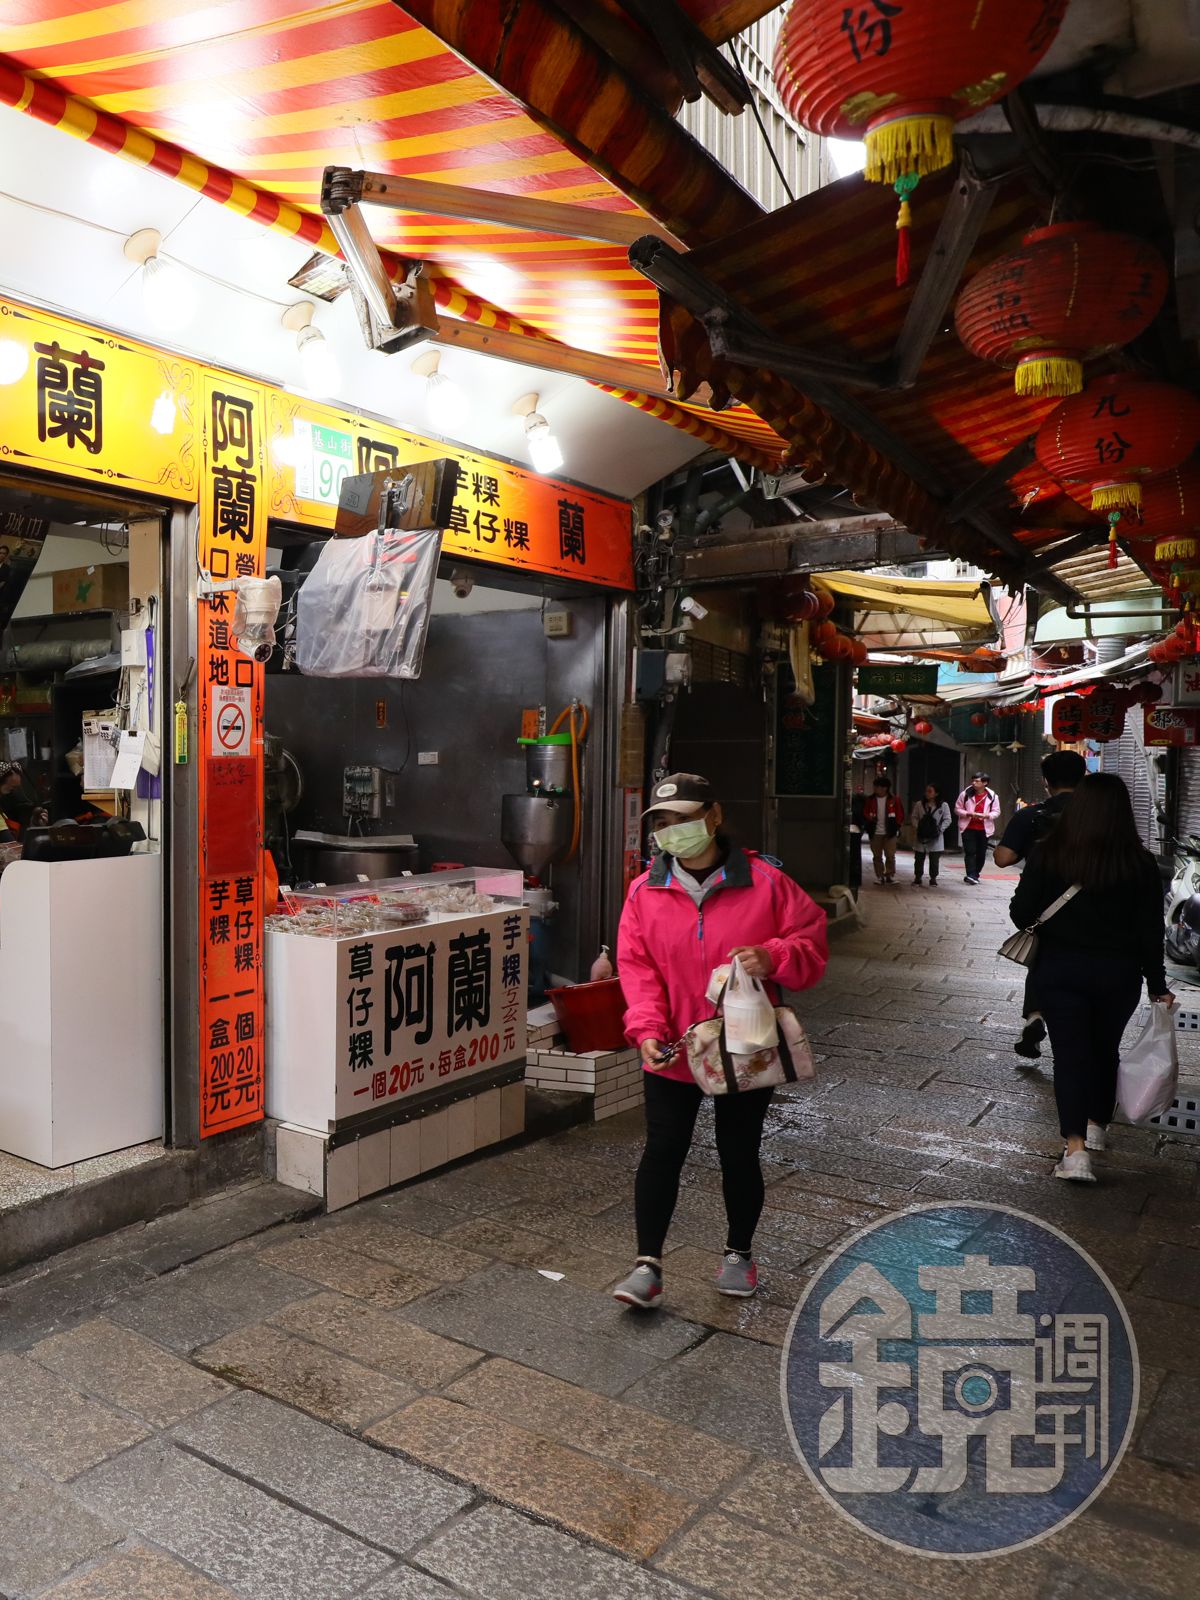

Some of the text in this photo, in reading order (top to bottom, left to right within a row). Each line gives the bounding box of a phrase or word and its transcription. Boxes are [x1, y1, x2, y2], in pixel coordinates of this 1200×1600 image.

[34, 339, 105, 455] 蘭
[1092, 394, 1132, 464] 九份
[211, 390, 257, 544] 阿蘭
[319, 459, 350, 499] 90
[450, 504, 531, 552] 草仔粿
[557, 498, 586, 565] 蘭
[209, 879, 231, 945] 芋粿
[233, 876, 255, 974] 草仔粿
[346, 941, 374, 1073] 草仔粿
[384, 927, 492, 1057] 阿蘭
